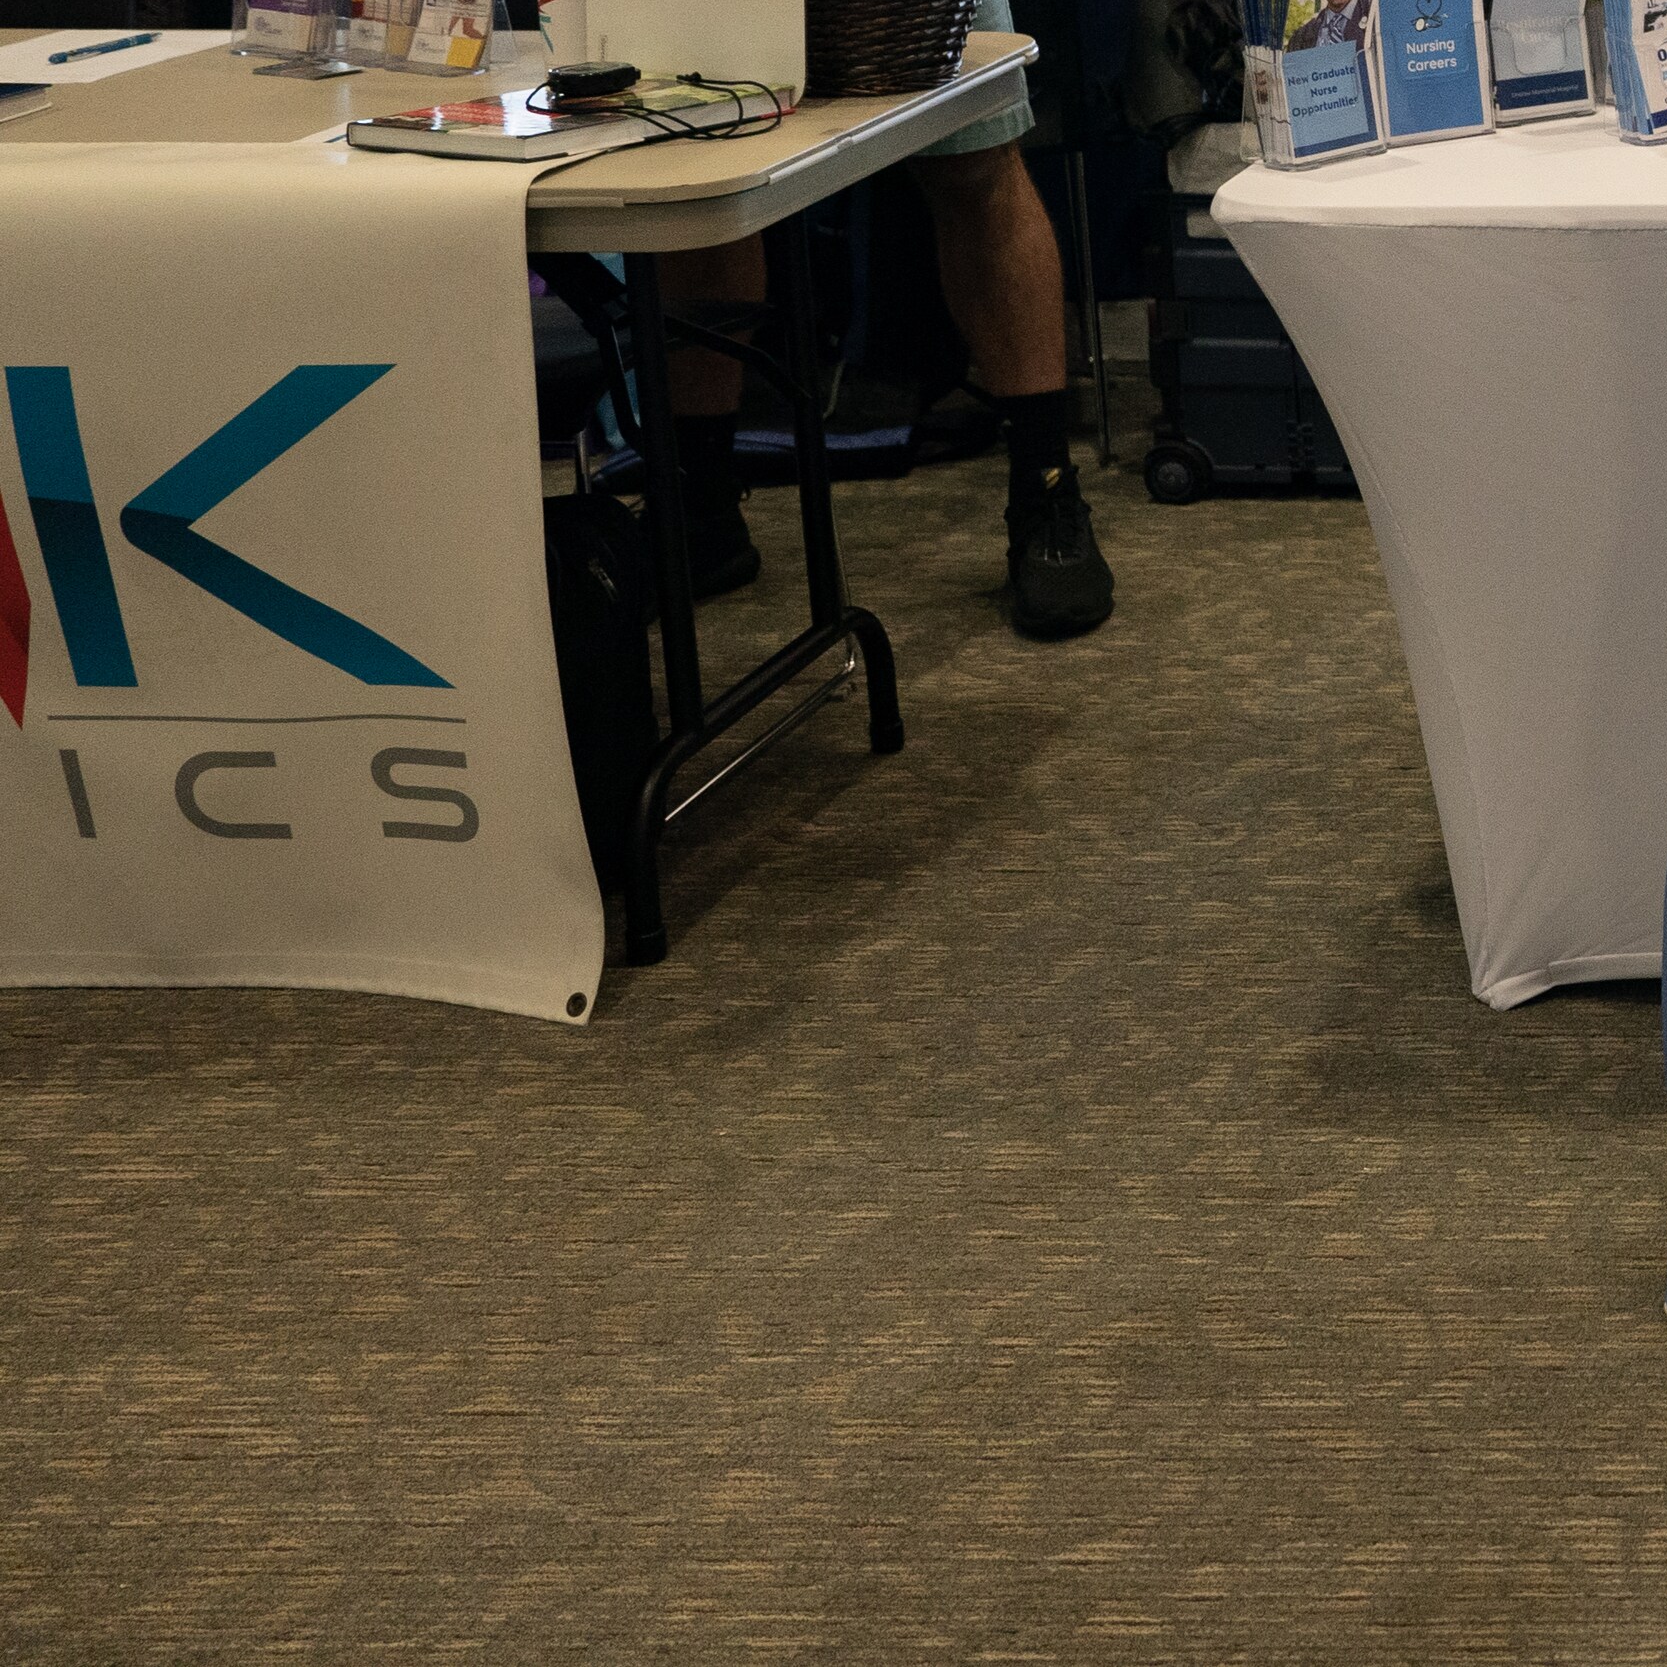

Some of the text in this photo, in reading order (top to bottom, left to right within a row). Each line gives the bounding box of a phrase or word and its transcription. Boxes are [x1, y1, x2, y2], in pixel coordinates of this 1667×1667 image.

[1406, 39, 1456, 54] Nursing
[1407, 57, 1457, 72] Careers
[1288, 65, 1356, 87] New Graduate
[1310, 85, 1338, 98] Nurse
[1291, 95, 1358, 118] Opportunities
